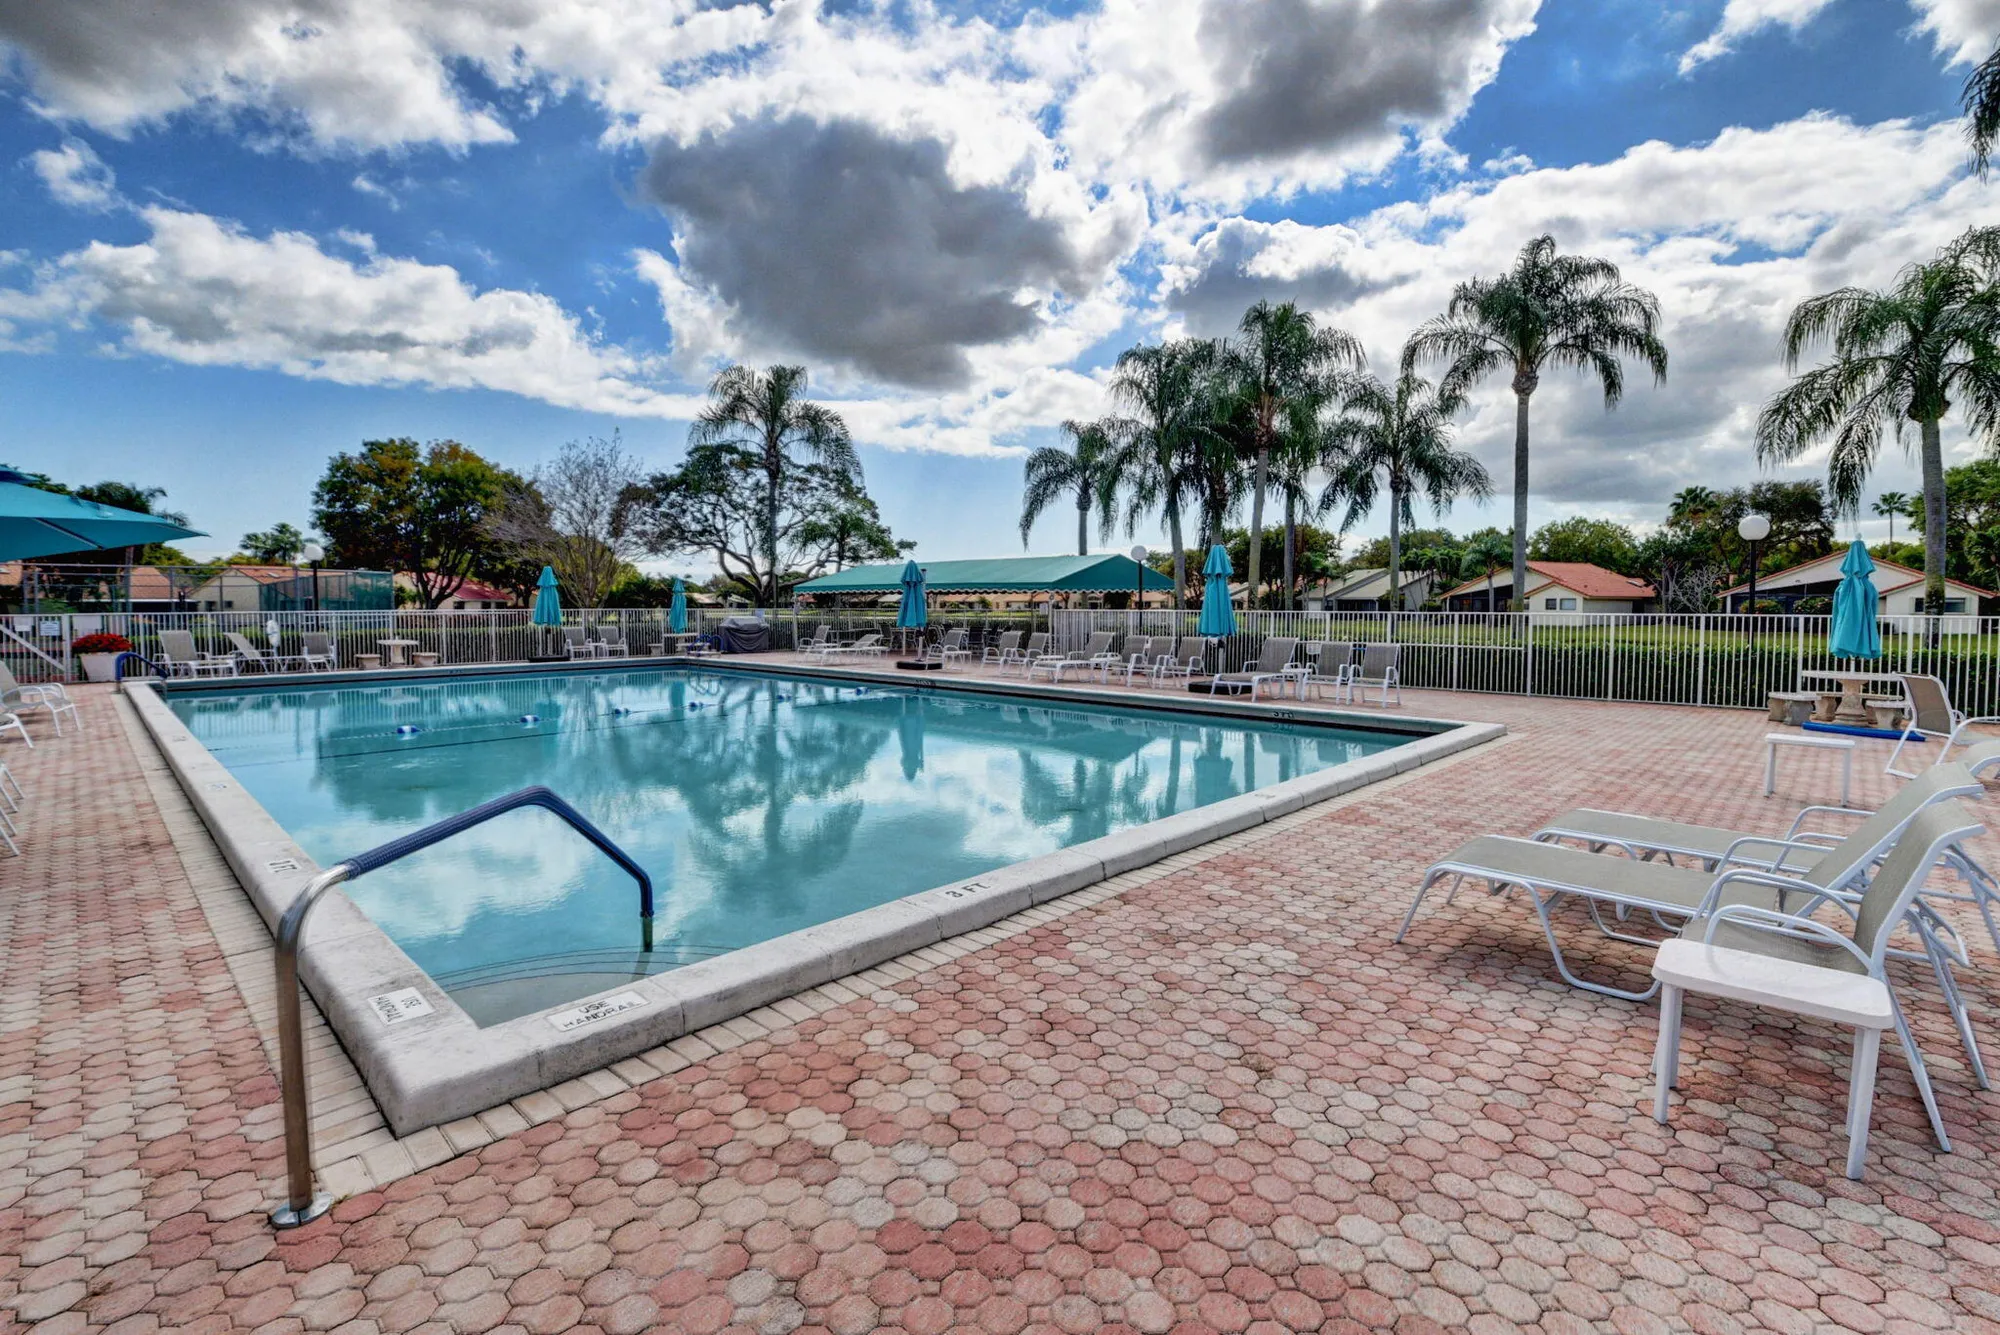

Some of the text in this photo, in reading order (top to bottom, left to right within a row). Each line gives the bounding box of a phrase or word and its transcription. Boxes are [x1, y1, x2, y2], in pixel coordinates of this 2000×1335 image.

[945, 882, 991, 898] 3 FT
[401, 995, 422, 1009] USE
[578, 1000, 610, 1014] USE
